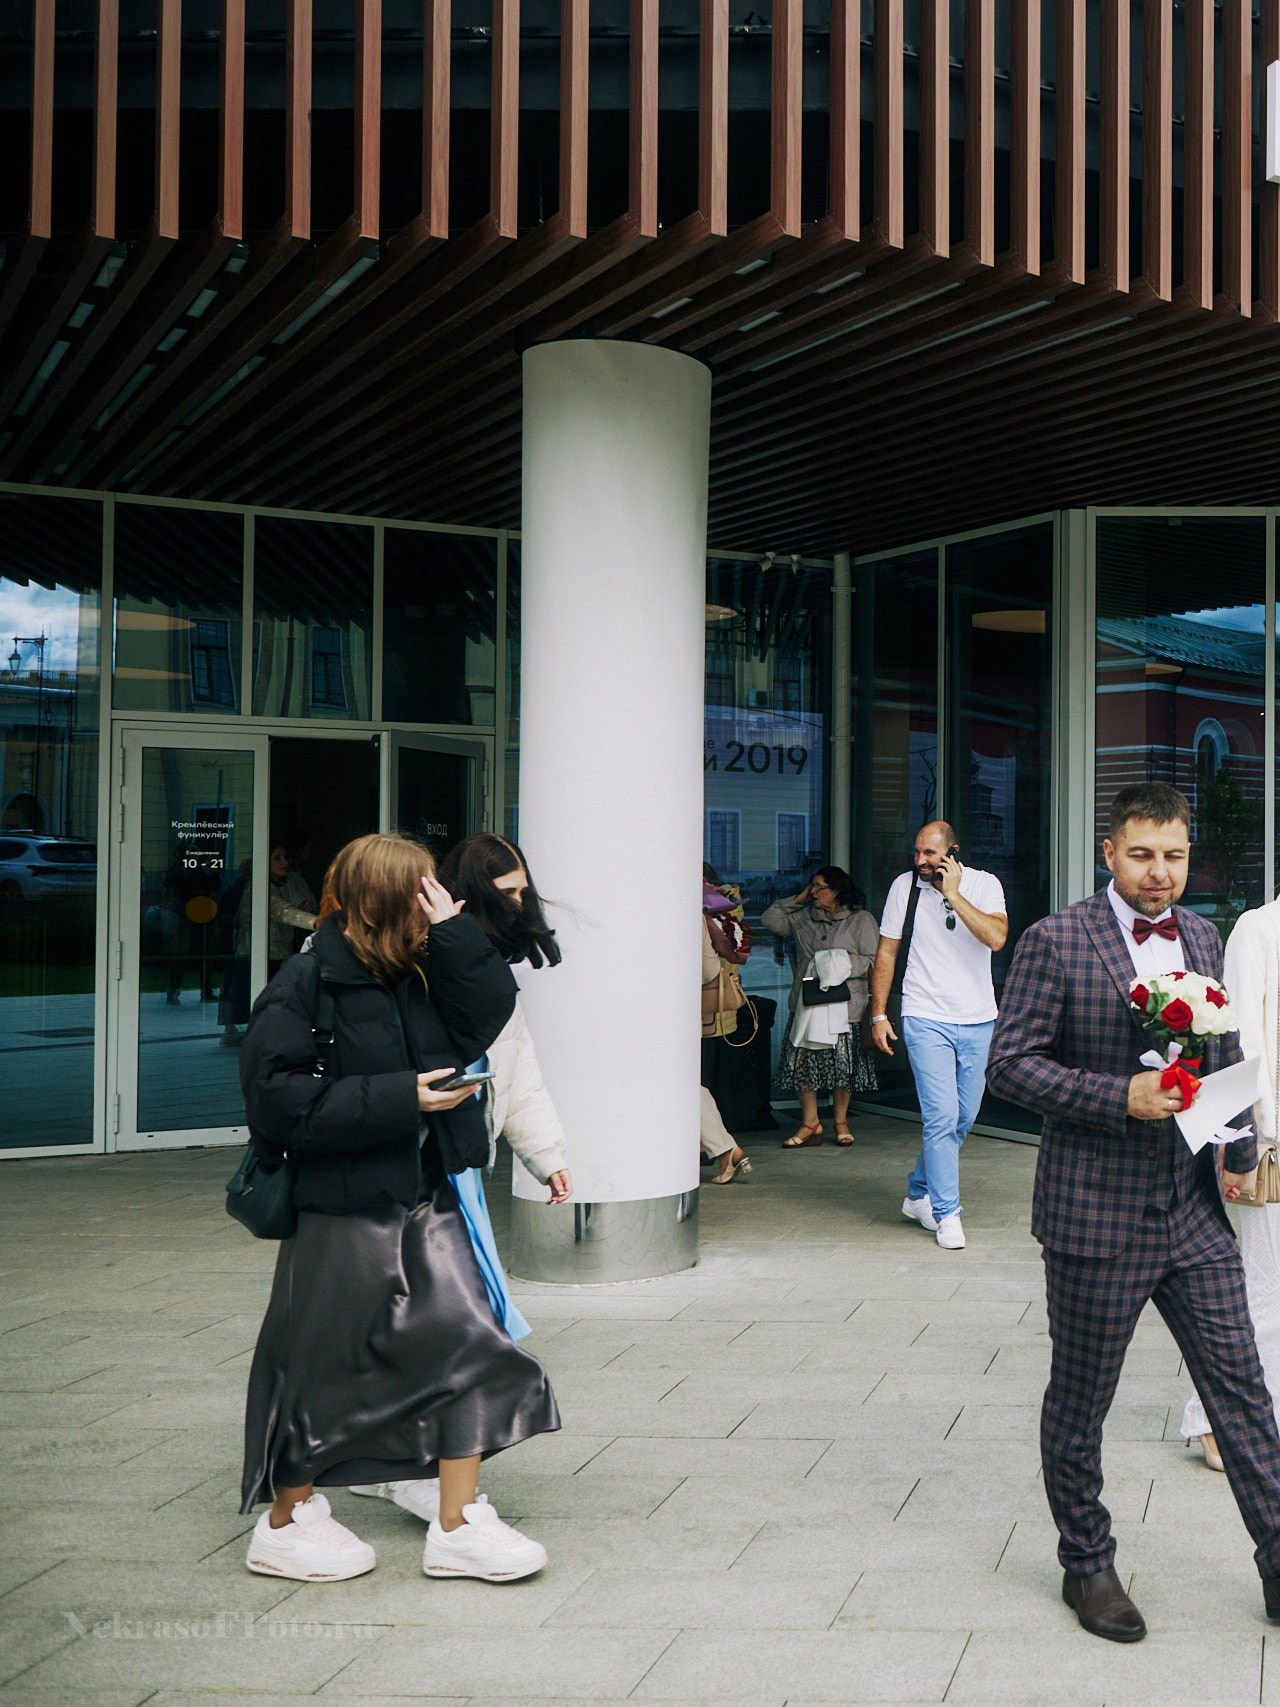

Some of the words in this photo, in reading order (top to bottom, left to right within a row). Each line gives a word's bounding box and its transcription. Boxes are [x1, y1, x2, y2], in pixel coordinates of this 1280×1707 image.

[724, 740, 808, 775] 2019
[171, 820, 235, 829] Кремлёвский
[177, 831, 229, 840] фуникулёр
[426, 823, 449, 838] ВХОД
[182, 859, 198, 869] 10
[210, 859, 224, 869] 21
